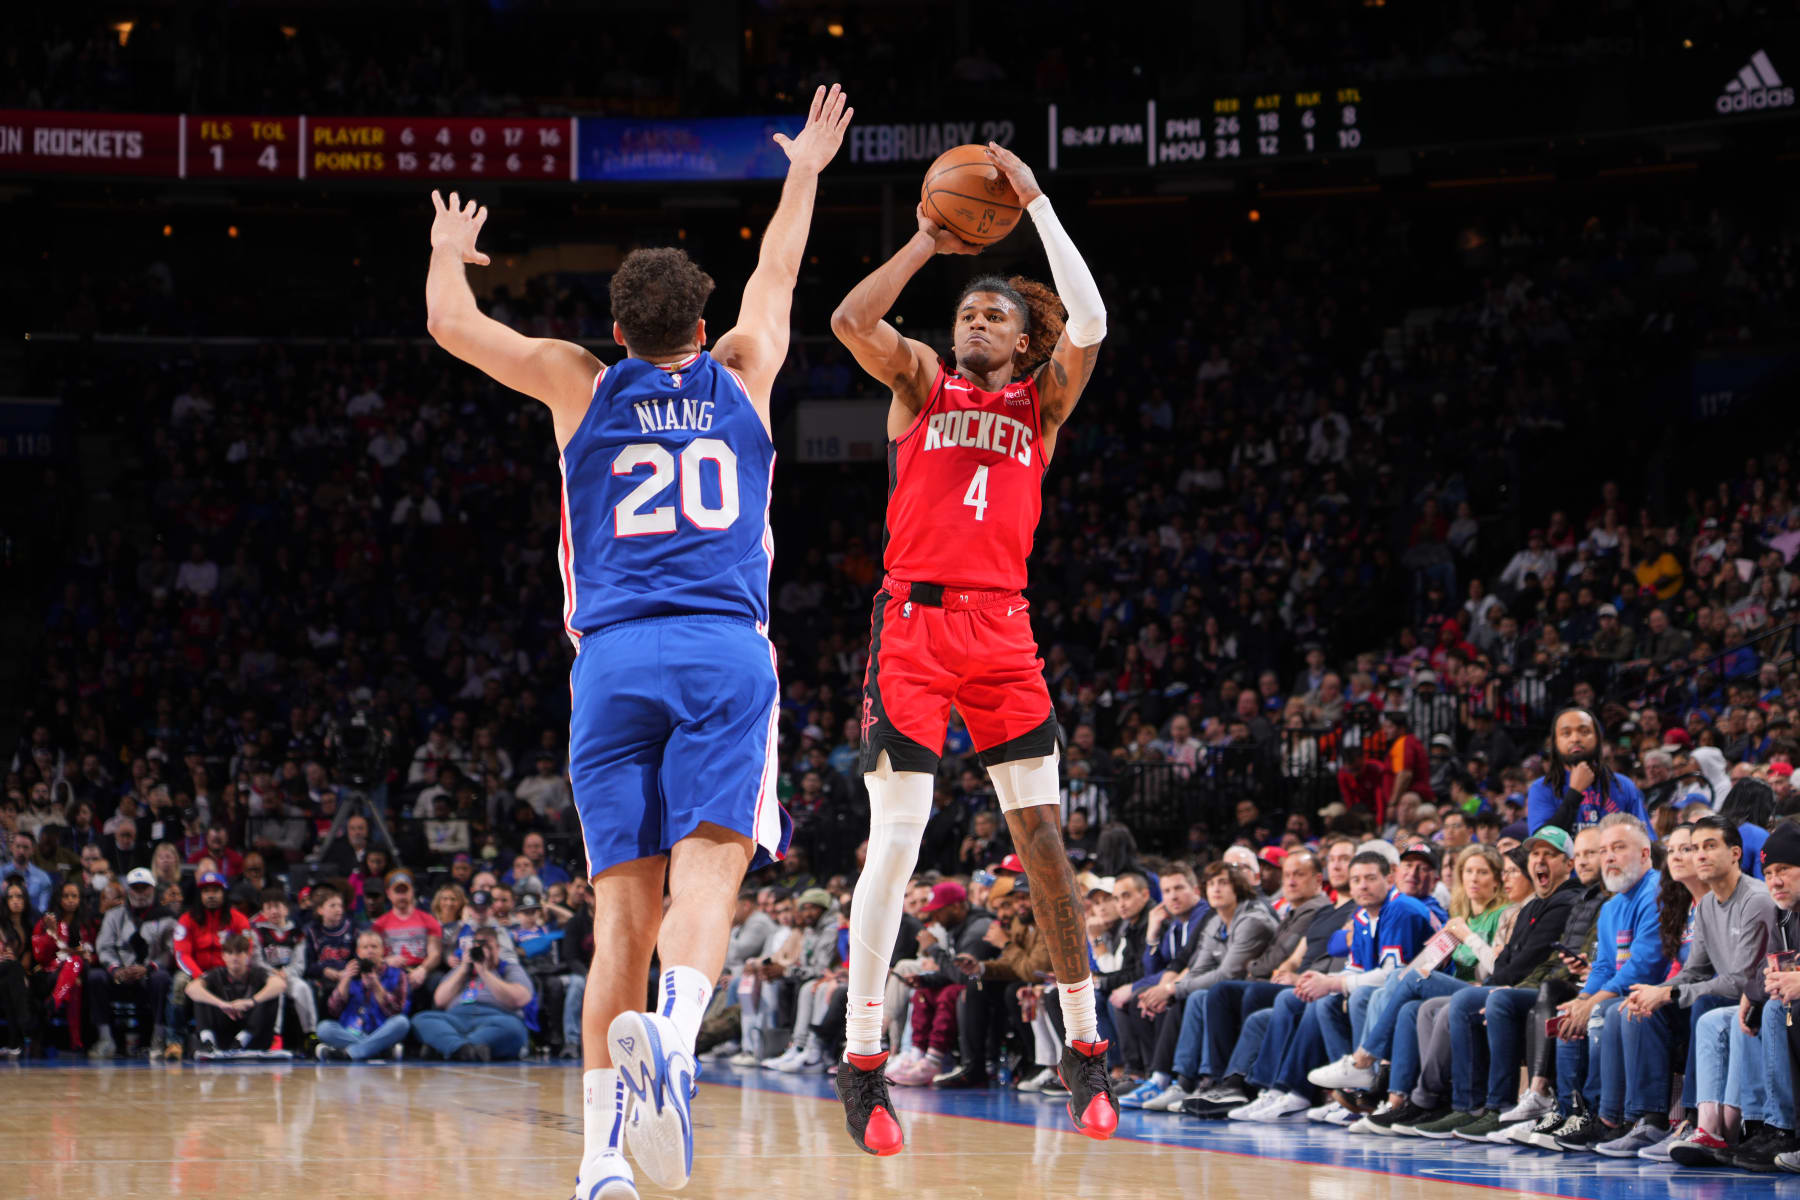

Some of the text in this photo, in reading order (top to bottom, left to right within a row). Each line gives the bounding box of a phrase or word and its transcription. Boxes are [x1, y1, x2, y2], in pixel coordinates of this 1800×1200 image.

[1716, 87, 1795, 113] adidas
[200, 120, 286, 142] FLS TOL
[313, 126, 561, 147] PLAYER 6 4 0 17 16
[1061, 123, 1143, 146] 8:47 PM
[1165, 117, 1201, 140] PHI
[1214, 116, 1240, 136] 26
[1257, 111, 1280, 133] 18
[1301, 110, 1316, 130] 6
[33, 127, 144, 159] ROCKETS
[850, 122, 976, 162] FEBRUARY
[1159, 128, 1361, 162] HOU 34 12 1 10
[209, 144, 279, 172] 1 4
[313, 151, 385, 172] POINTS
[397, 152, 418, 171] 15
[428, 152, 456, 171] 26
[470, 152, 486, 172] 2
[506, 152, 522, 172] 6
[633, 398, 715, 434] NIANG
[923, 410, 1033, 467] ROCKETS
[611, 437, 740, 538] 20
[962, 464, 989, 521] 4
